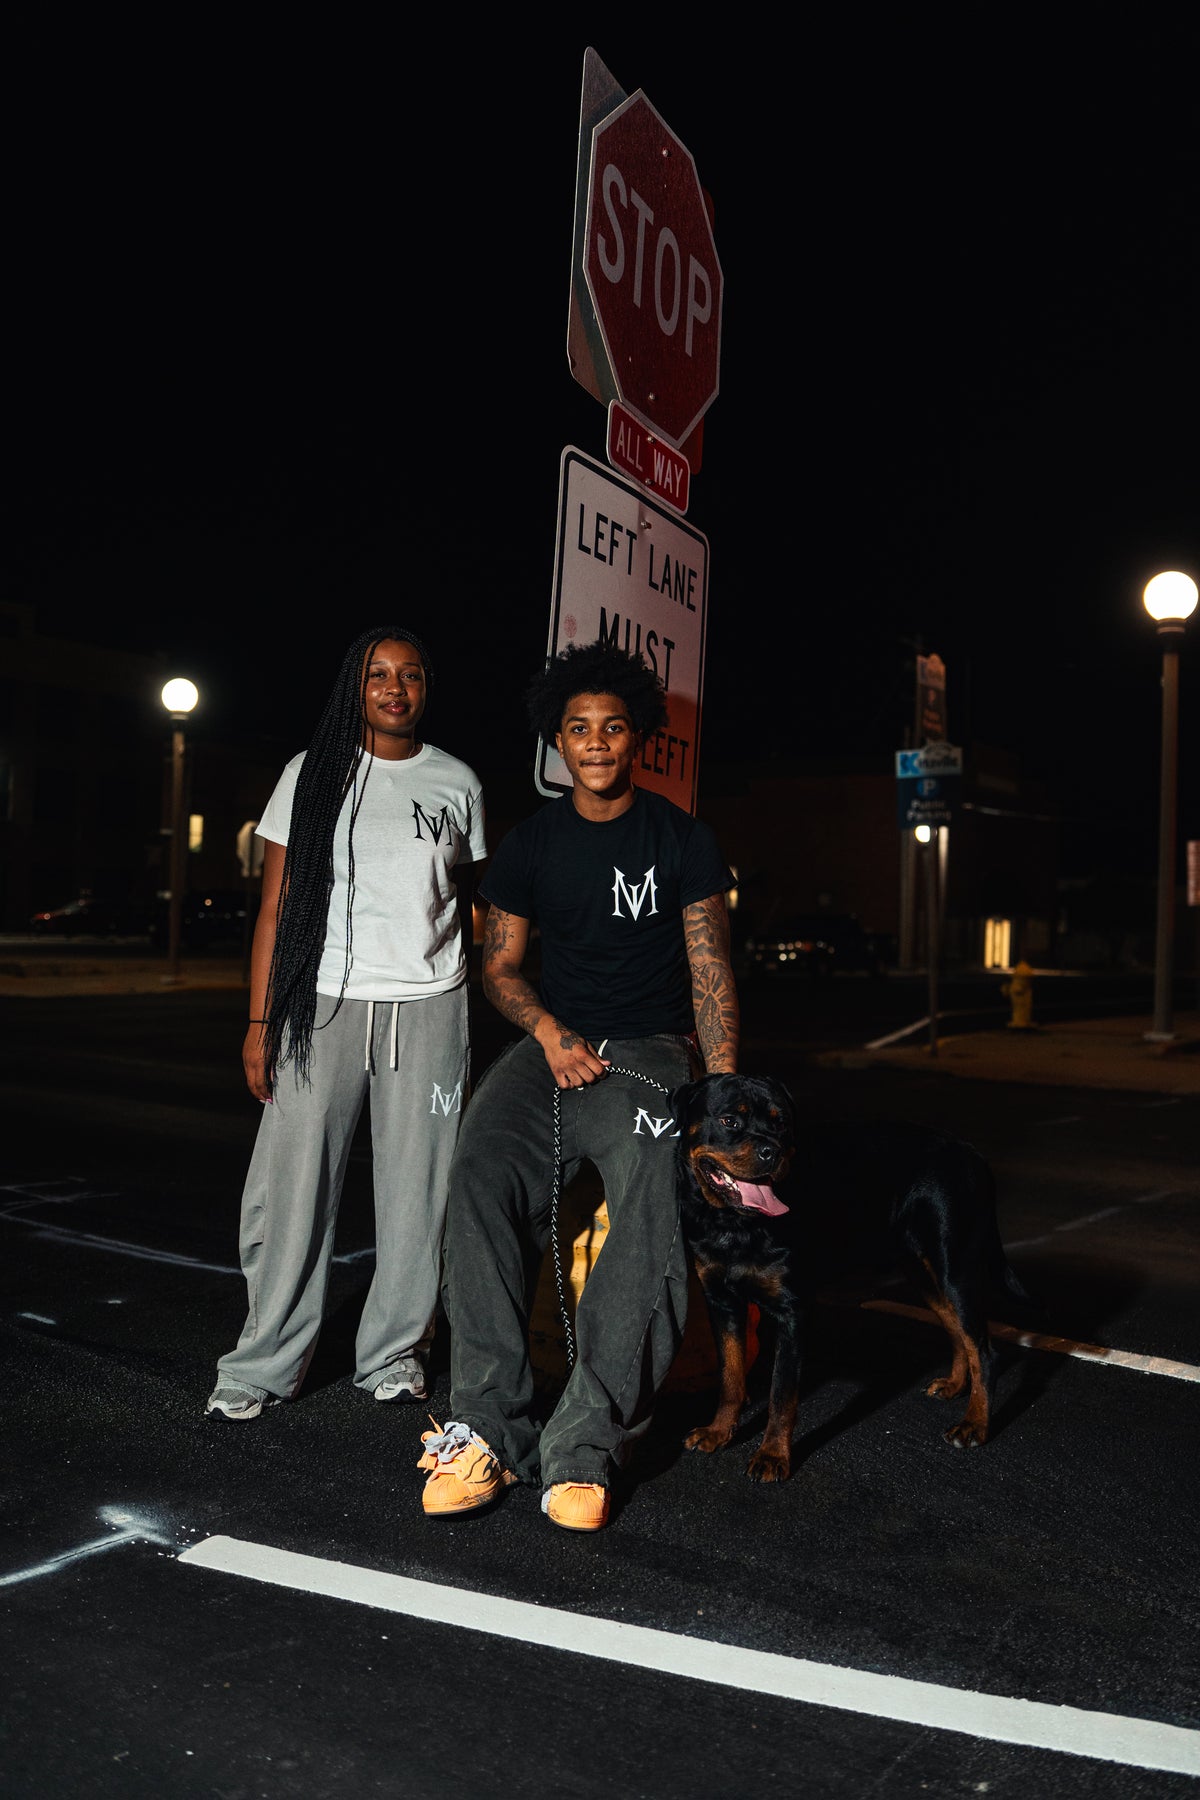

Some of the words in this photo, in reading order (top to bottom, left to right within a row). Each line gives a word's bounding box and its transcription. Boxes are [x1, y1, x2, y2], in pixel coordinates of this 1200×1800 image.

[597, 163, 712, 358] STOP
[616, 421, 643, 472] ALL
[653, 449, 683, 498] WAY
[578, 503, 637, 575] LEFT
[648, 543, 697, 612] LANE
[599, 607, 675, 692] MUST
[641, 729, 688, 781] LEFT
